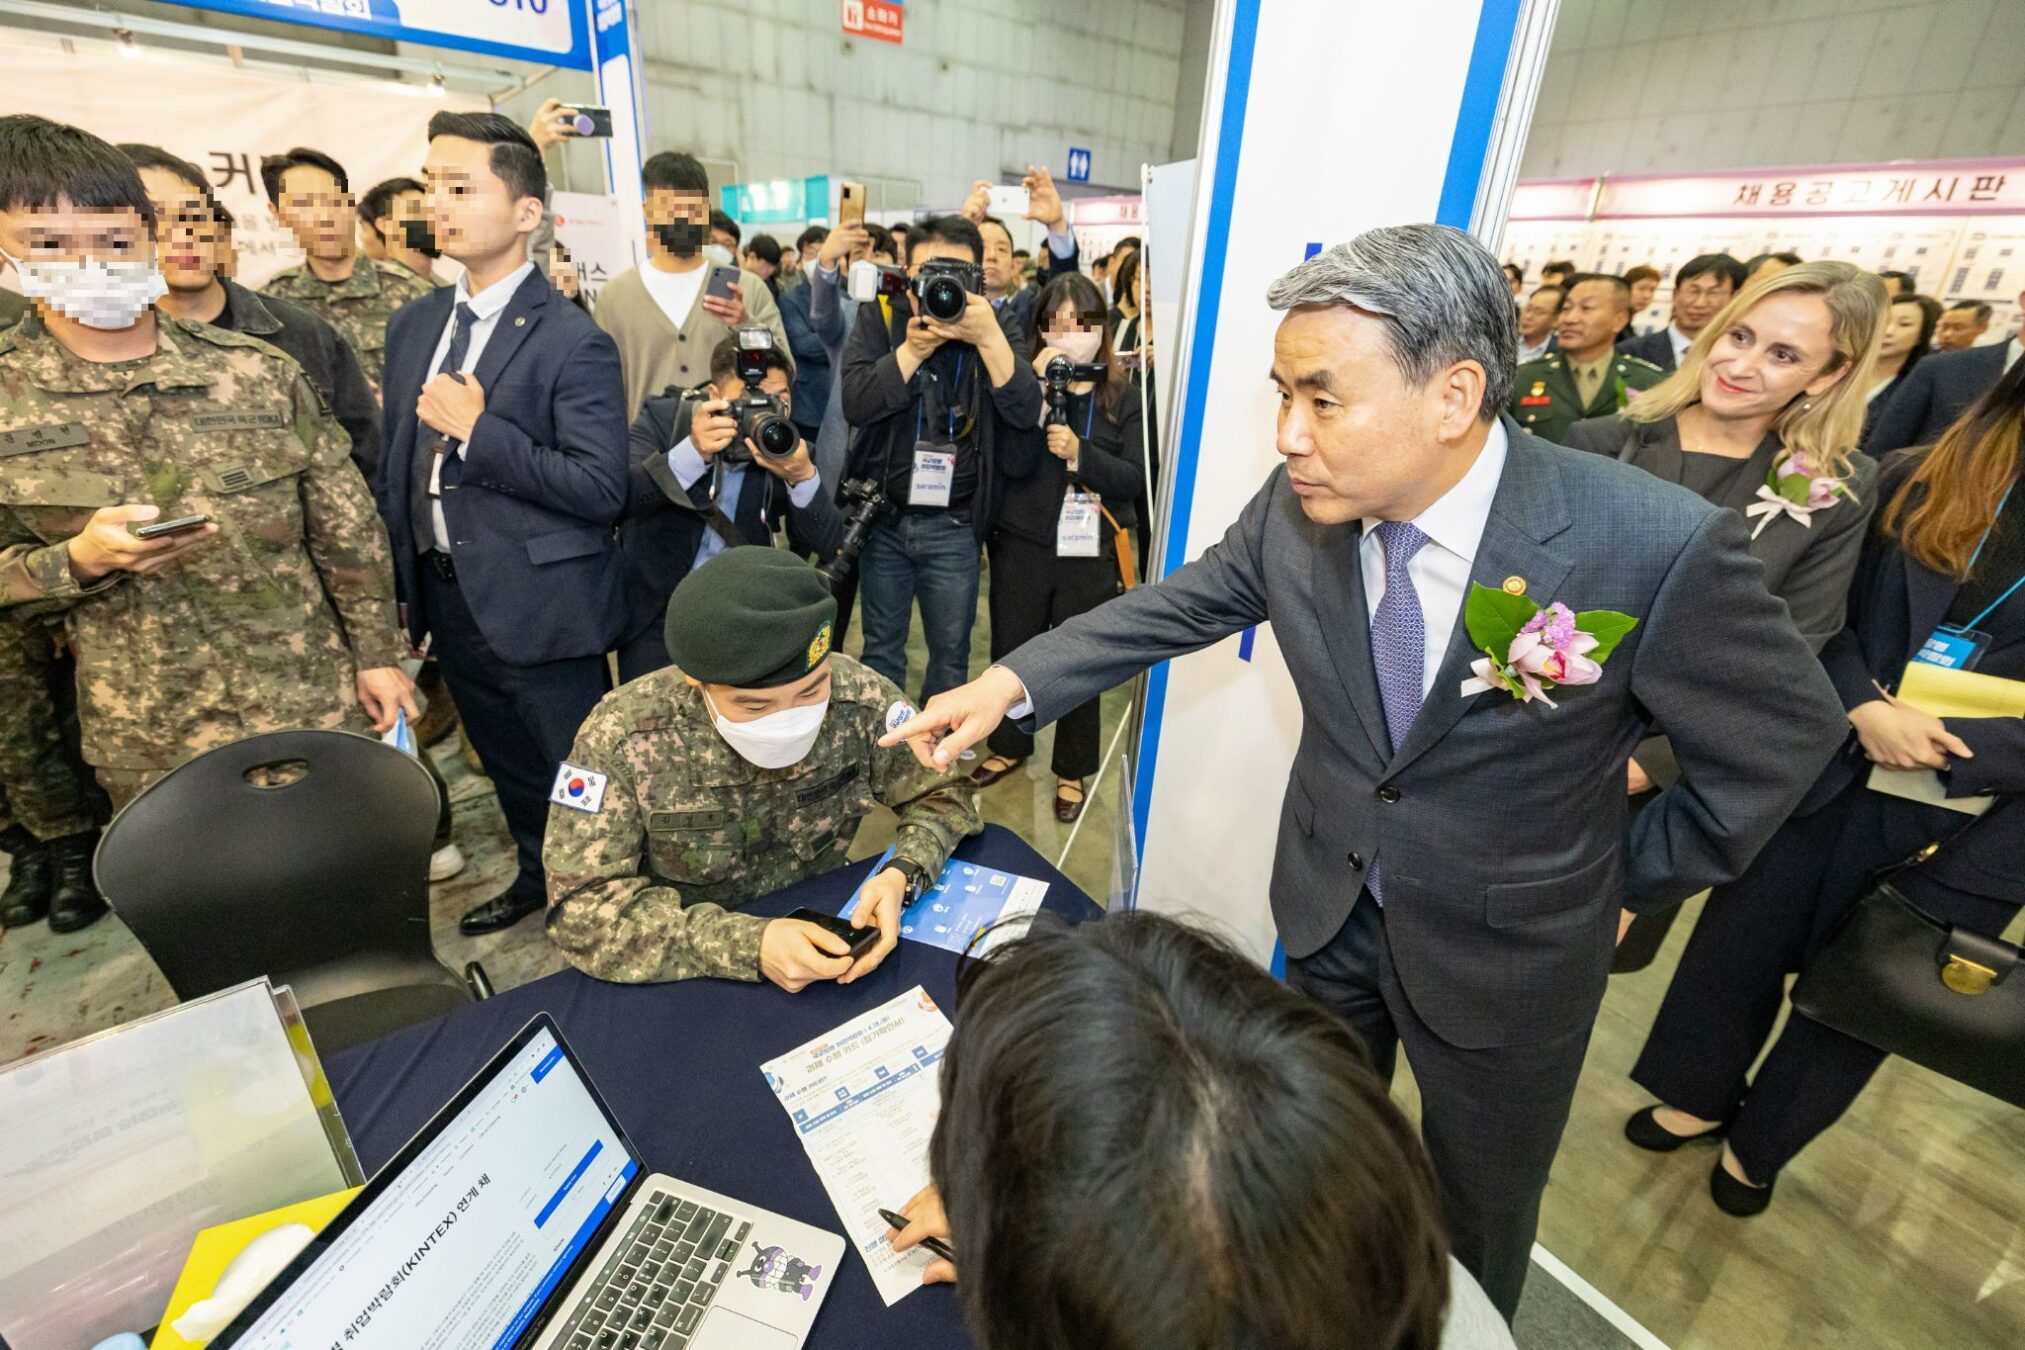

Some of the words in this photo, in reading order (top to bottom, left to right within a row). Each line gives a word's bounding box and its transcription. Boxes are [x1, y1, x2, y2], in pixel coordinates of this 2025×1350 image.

[1734, 175, 2005, 207] 채용공고게시판
[343, 1209, 459, 1342] 취업박람회(KINTEX)
[456, 1185, 481, 1213] 연계
